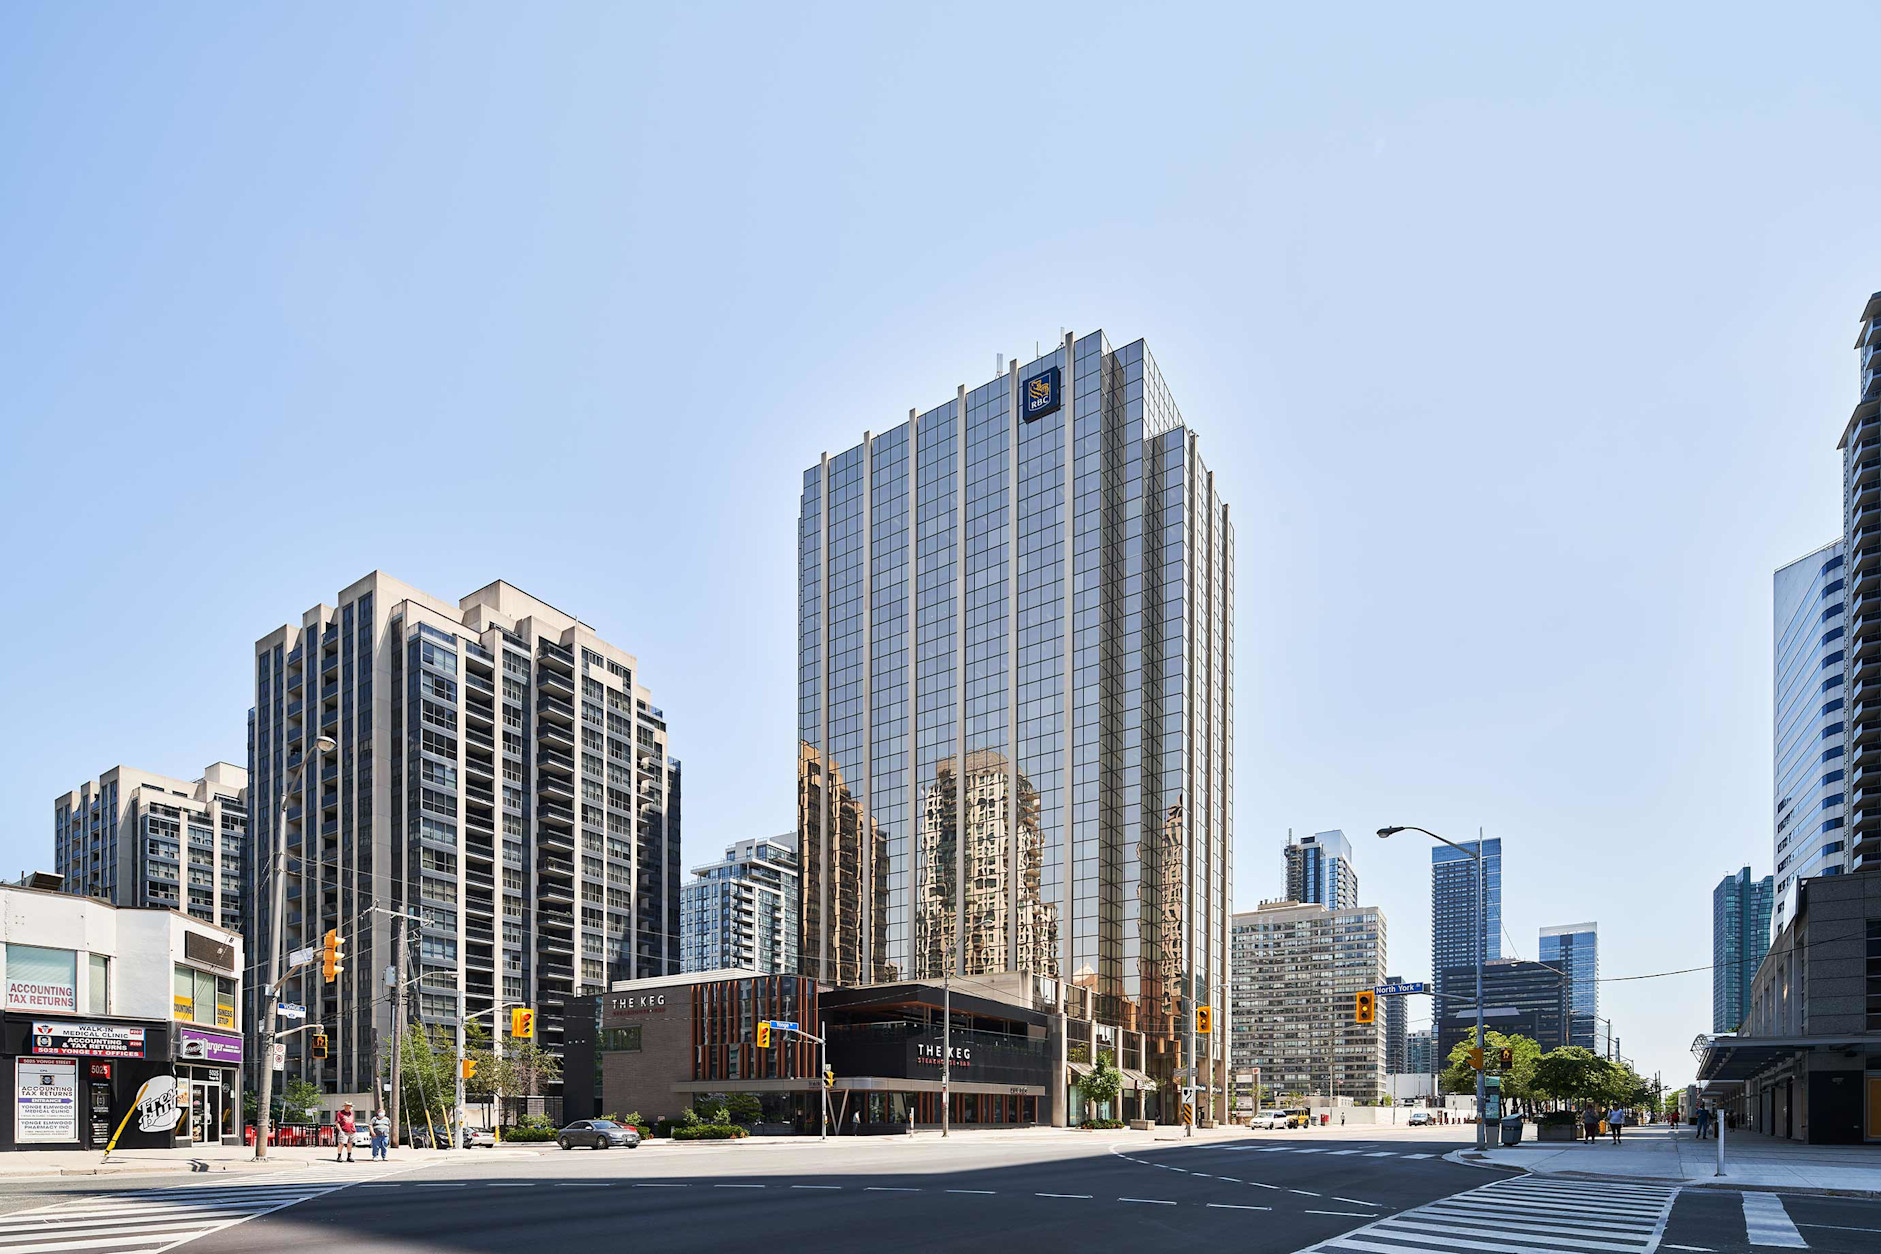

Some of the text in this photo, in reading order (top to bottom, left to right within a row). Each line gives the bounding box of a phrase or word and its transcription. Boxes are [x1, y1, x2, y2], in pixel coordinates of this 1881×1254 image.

[1031, 396, 1048, 409] RBC
[10, 983, 73, 997] ACCOUNTING
[1376, 986, 1396, 994] North
[1398, 984, 1415, 992] York
[8, 993, 74, 1007] TAX RETURNS
[612, 994, 665, 1010] THE KEG
[78, 1025, 114, 1033] WALK-IN
[67, 1037, 122, 1045] ACCOUNTING
[918, 1044, 971, 1060] THE KEG
[917, 1057, 956, 1066] STEAKHOSE
[91, 1065, 108, 1075] 5025
